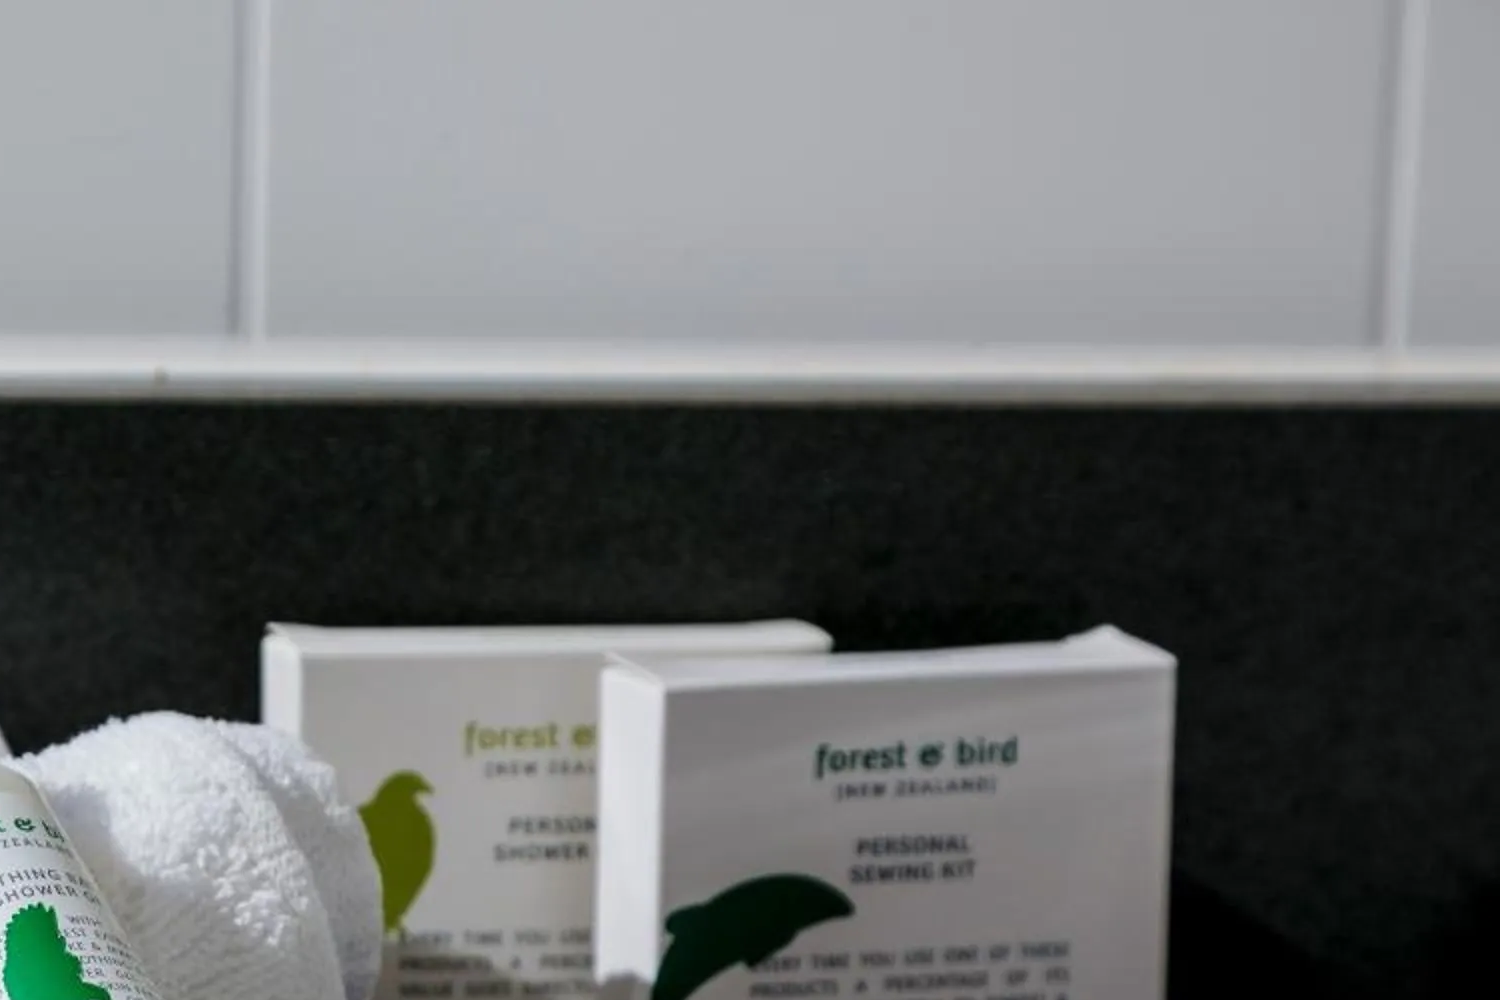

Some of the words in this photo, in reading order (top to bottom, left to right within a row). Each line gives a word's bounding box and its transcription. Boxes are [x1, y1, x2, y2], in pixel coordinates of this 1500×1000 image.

[465, 720, 558, 757] forest
[815, 741, 906, 780] forest
[919, 742, 945, 768] &
[956, 736, 1018, 768] bird
[14, 817, 36, 833] &
[509, 816, 596, 834] PERSON
[856, 836, 969, 856] PERSONAL
[850, 863, 934, 884] SEWING
[941, 858, 976, 878] KIT
